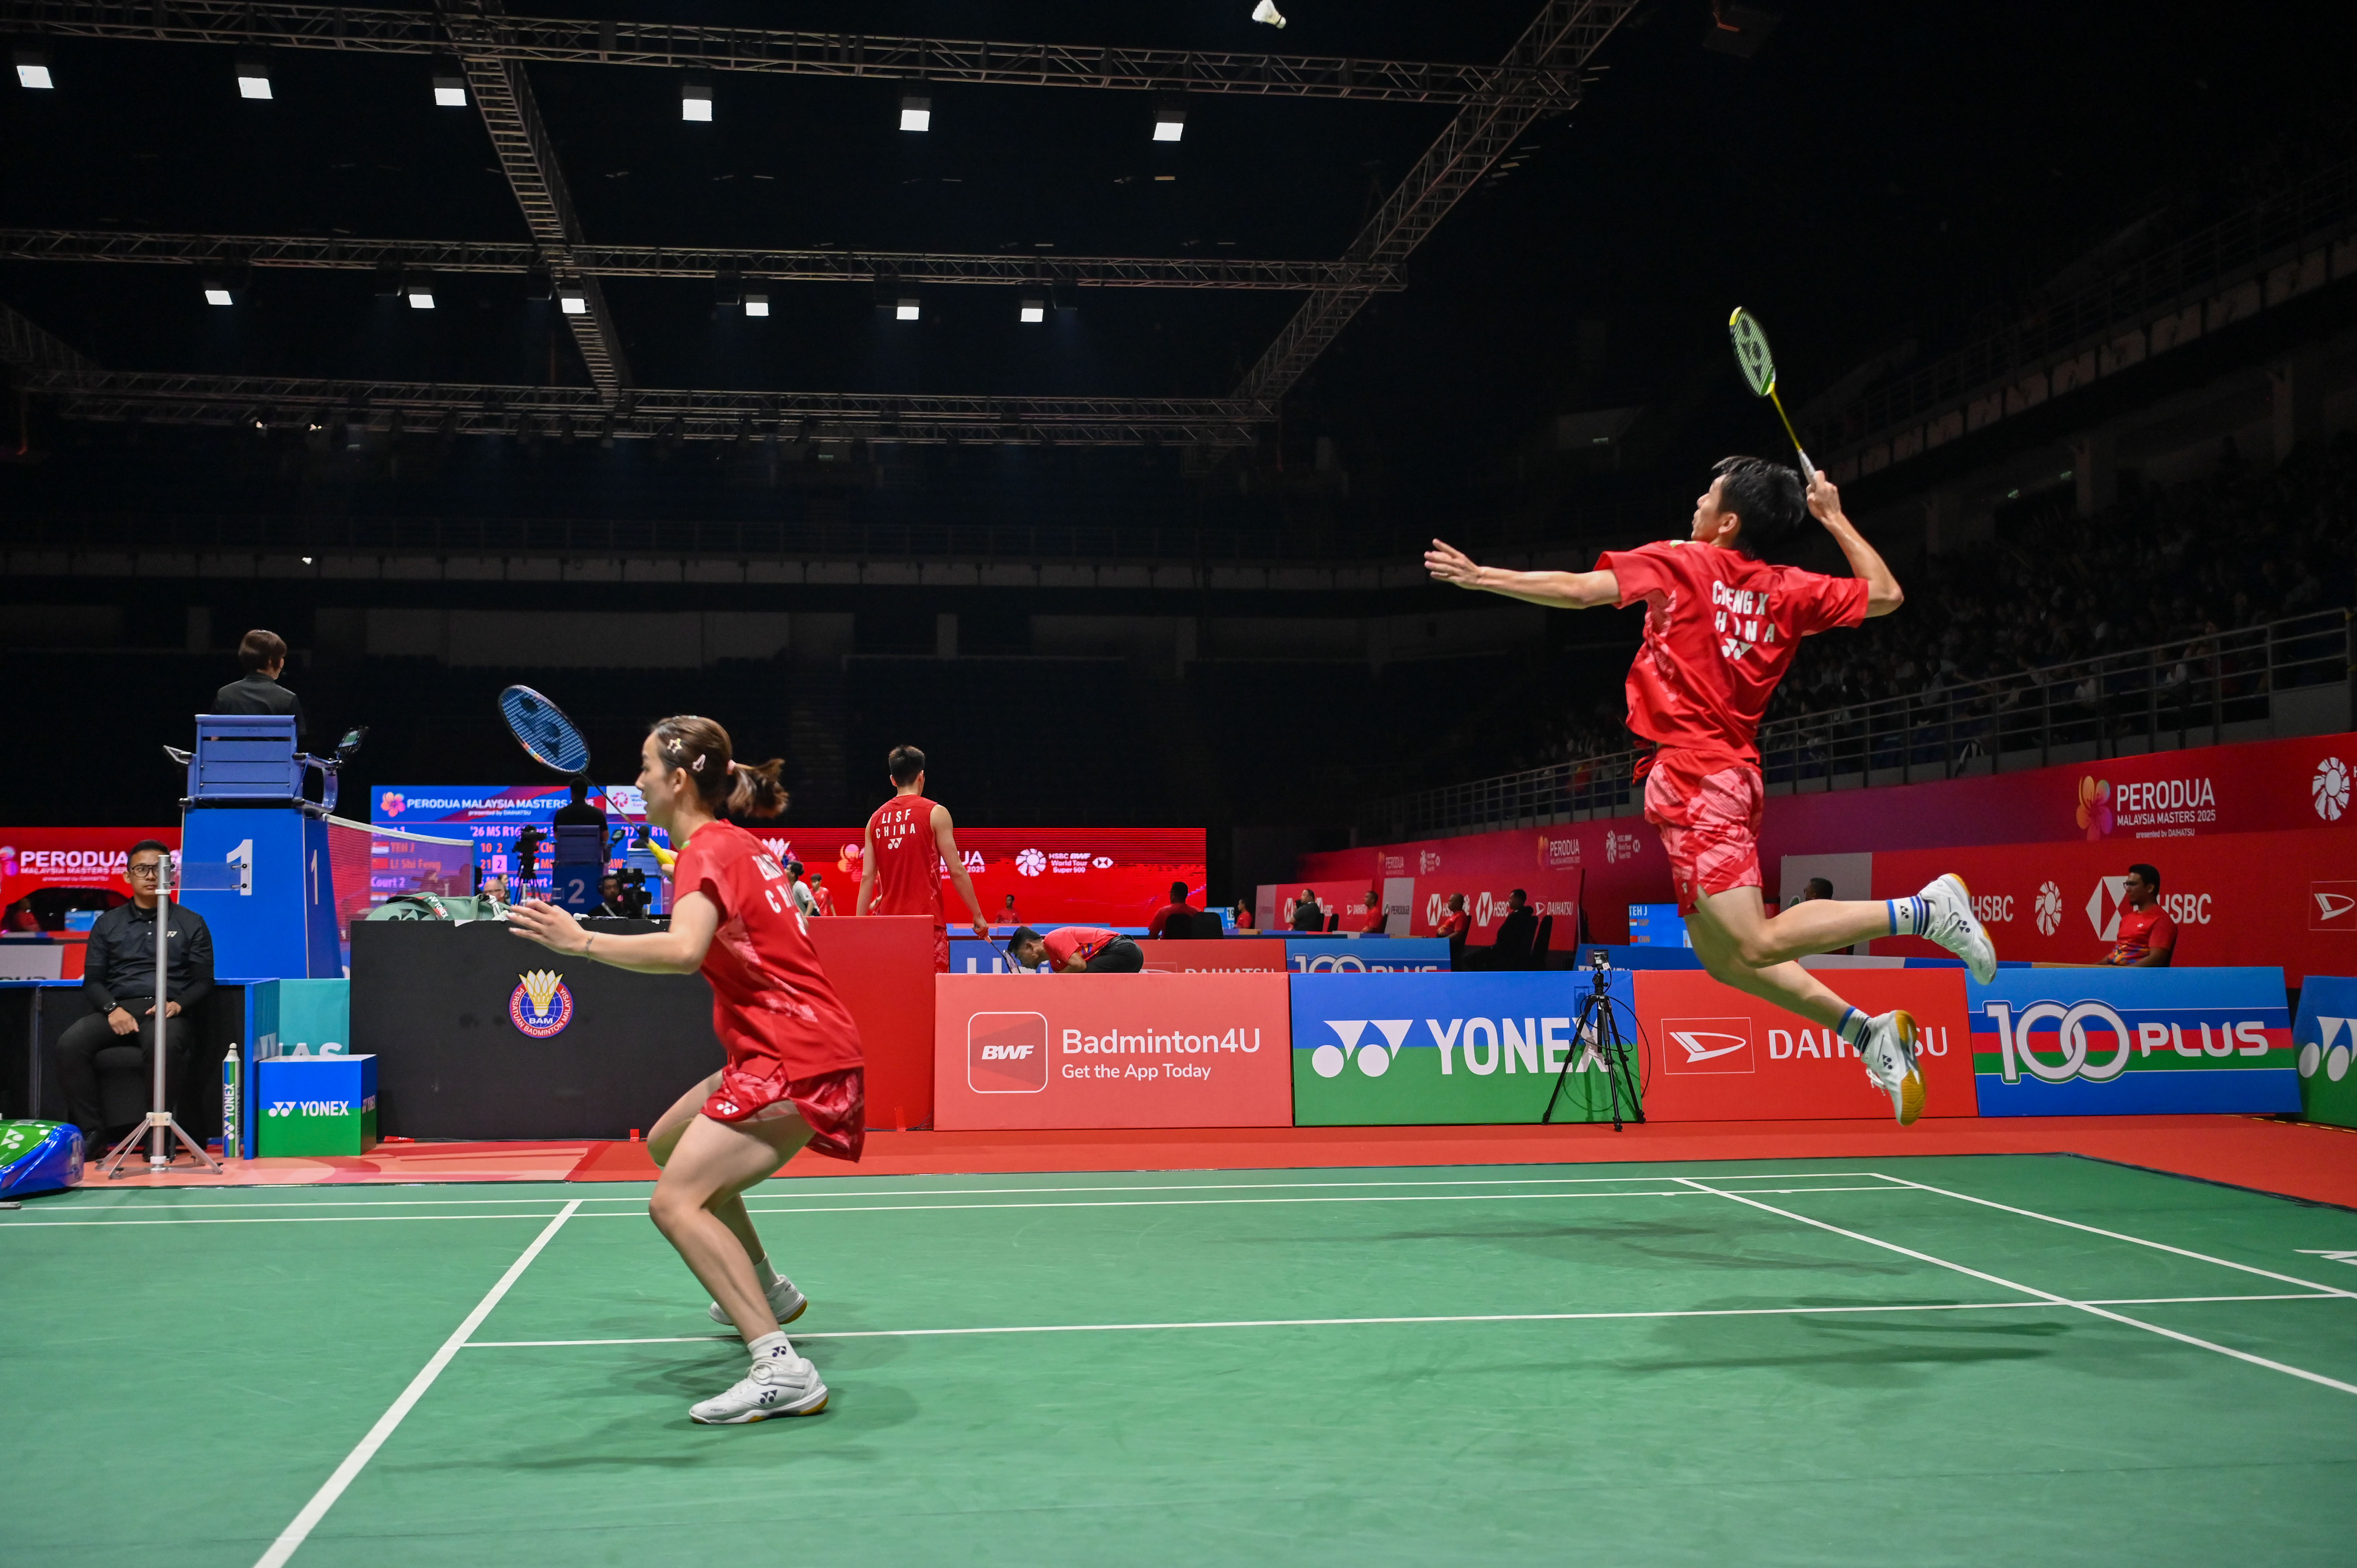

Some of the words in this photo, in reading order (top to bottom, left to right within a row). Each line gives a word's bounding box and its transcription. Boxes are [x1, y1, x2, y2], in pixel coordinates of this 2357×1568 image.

[1755, 592, 1769, 615] X
[2117, 778, 2216, 812] PERODUA
[407, 799, 460, 808] PERODUA
[462, 799, 515, 808] MALAYSIA
[516, 799, 567, 809] MASTERS
[882, 812, 891, 824] LI
[2117, 813, 2155, 826] MALAYSIA
[2157, 810, 2196, 824] MASTERS
[2197, 810, 2216, 822] 2025
[486, 827, 501, 837] MS
[876, 823, 916, 839] CHINA
[2168, 828, 2195, 837] DAIHATSU
[481, 843, 492, 853] 10
[496, 843, 503, 853] 2
[1550, 838, 1580, 857] PERODUA
[21, 851, 128, 868] PERODUA
[226, 839, 253, 896] 1
[481, 859, 491, 869] 21
[497, 860, 502, 868] 2
[311, 849, 319, 905] 1
[371, 876, 397, 888] Court
[399, 877, 405, 888] 2
[568, 879, 585, 904] 2
[434, 901, 449, 919] YONEX
[1493, 901, 1509, 916] HSBC
[1547, 902, 1573, 916] DAIHATSU
[1629, 906, 1642, 916] TEH
[1643, 906, 1648, 916] J
[1972, 895, 2013, 922] HSBC
[2157, 893, 2212, 924] HSBC
[512, 988, 525, 1027] PERSATUAN
[524, 1021, 563, 1035] BADMINTON
[560, 988, 570, 1022] MALAYSIA
[1062, 1028, 1260, 1054] Badminton4U
[1426, 1017, 1609, 1075] YONEX
[1768, 1027, 1948, 1060] DAIHSU
[1986, 1002, 2130, 1080] 100
[2138, 1021, 2268, 1058] PLUS
[982, 1045, 1034, 1060] BWF
[1062, 1064, 1090, 1078] Get
[1094, 1064, 1120, 1078] the
[1124, 1064, 1158, 1081] App
[1162, 1064, 1211, 1081] Today
[224, 1083, 235, 1118] YONEX
[299, 1101, 349, 1116] YONEX
